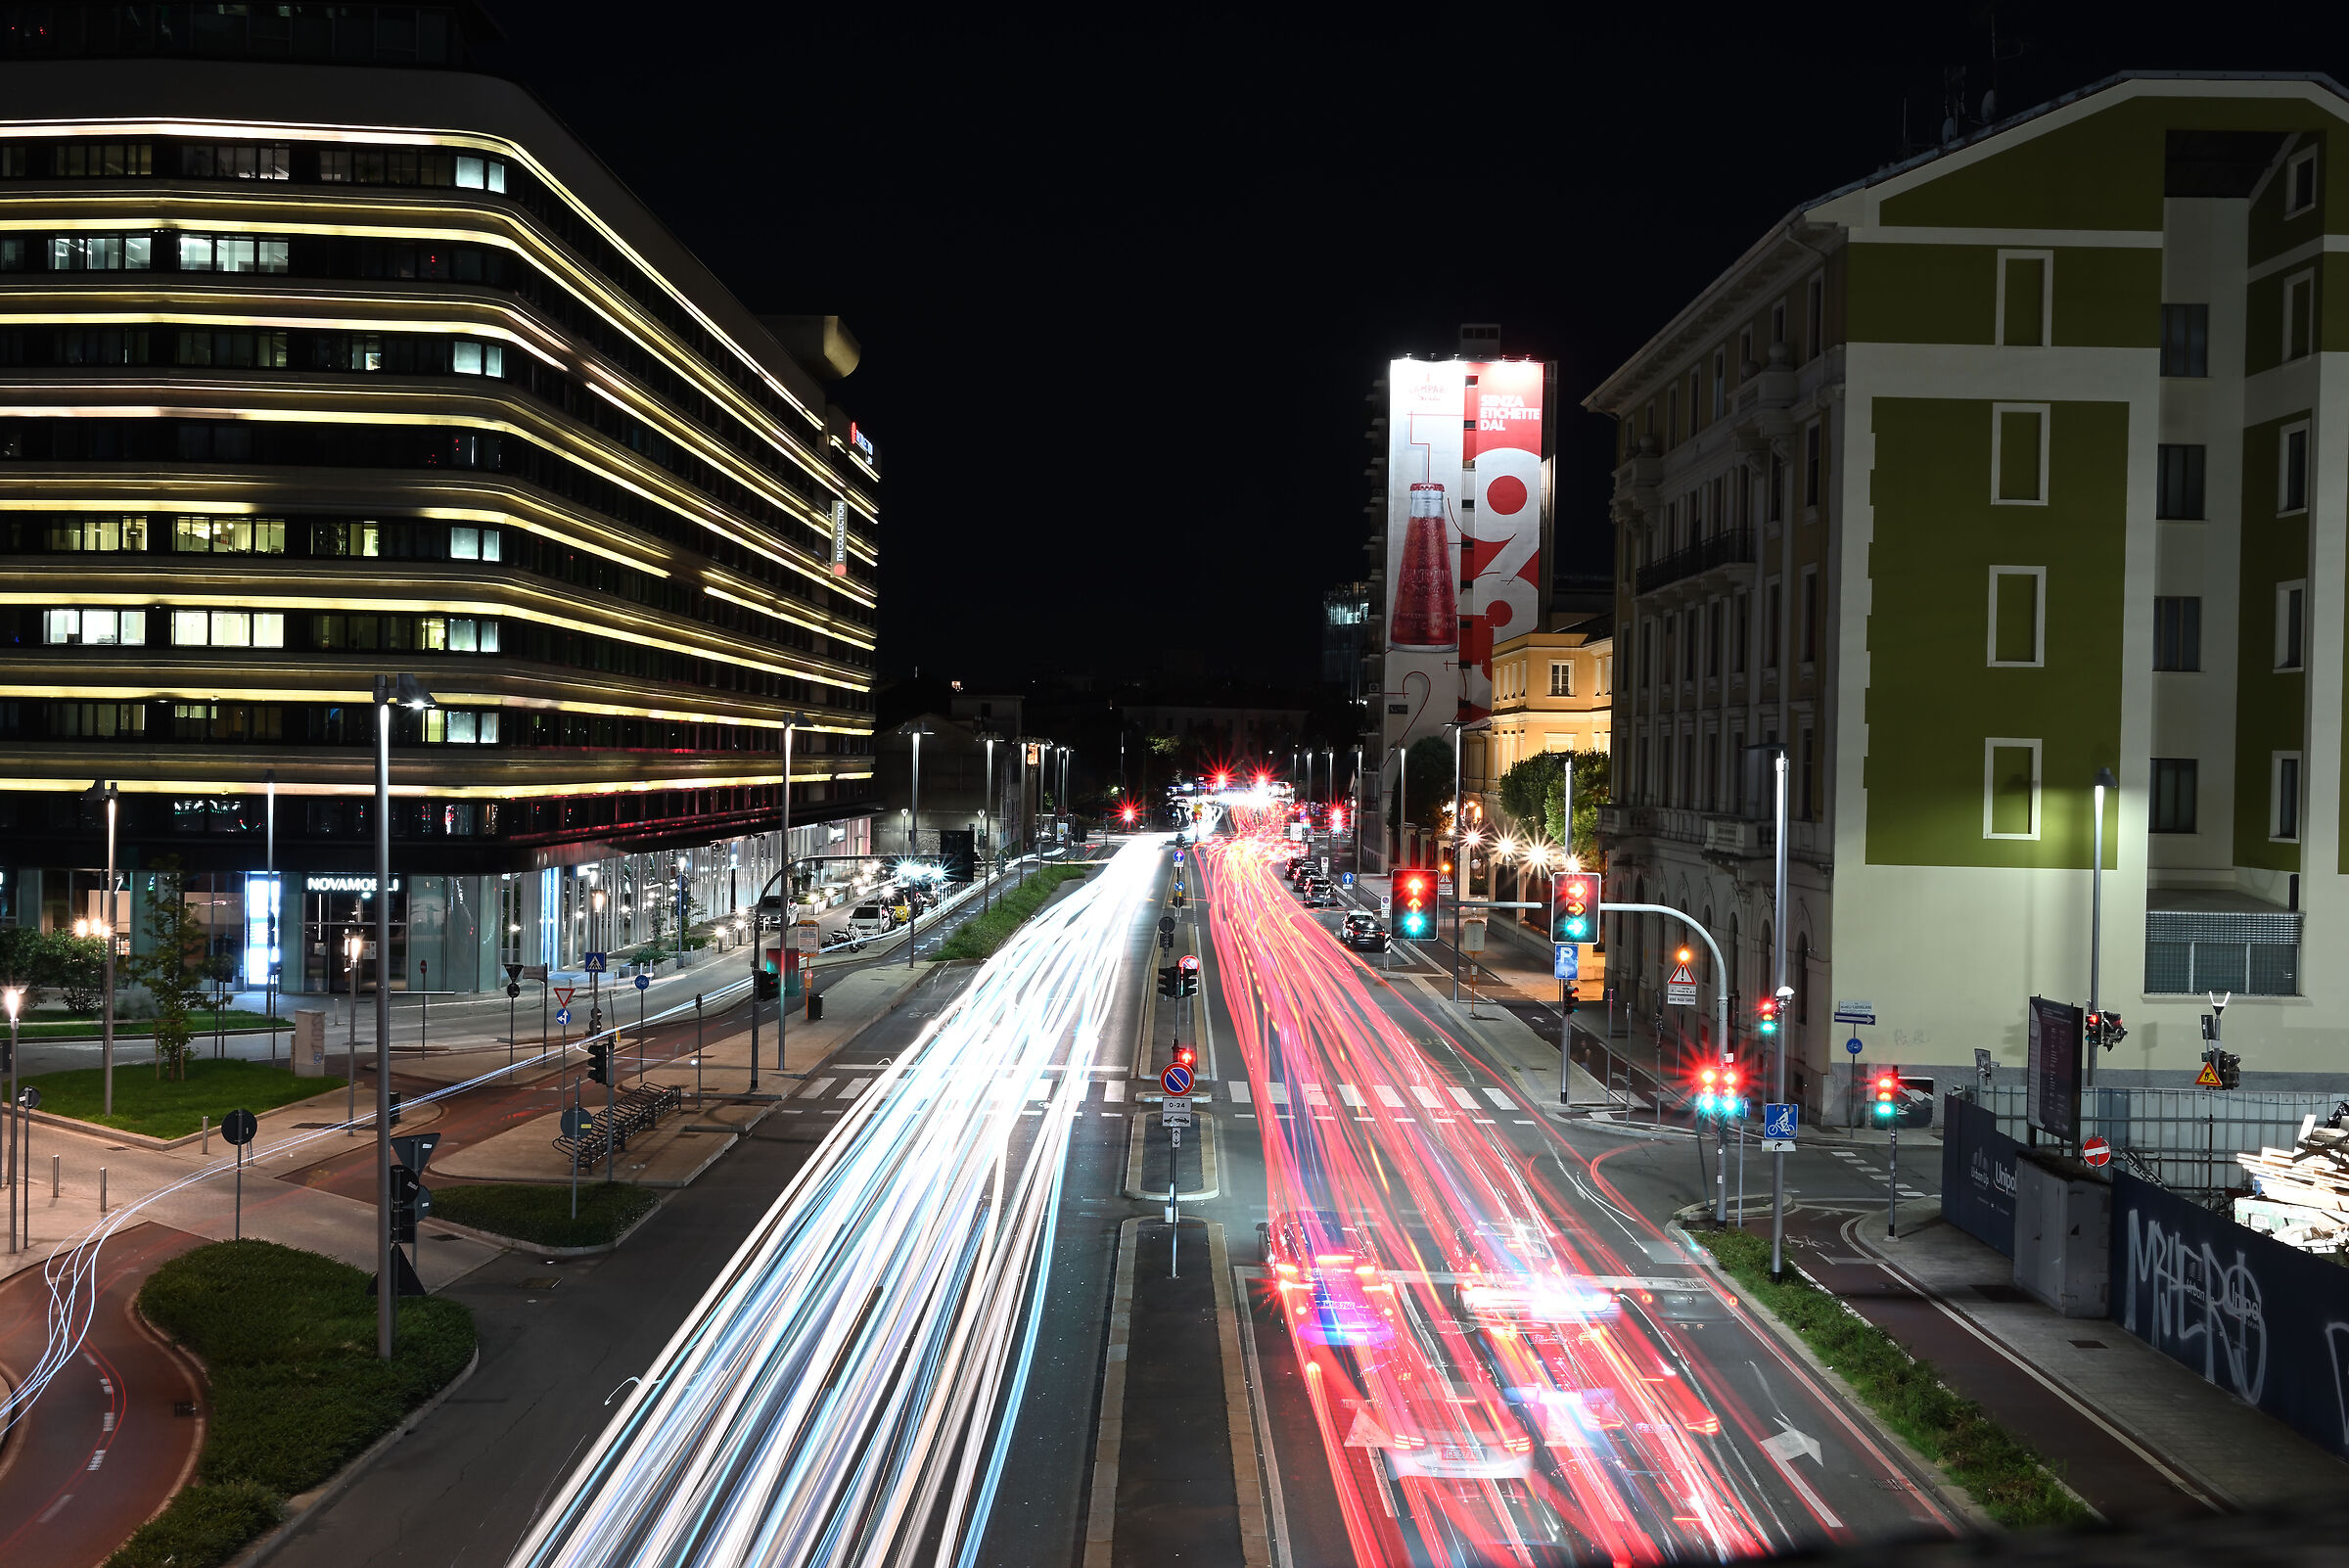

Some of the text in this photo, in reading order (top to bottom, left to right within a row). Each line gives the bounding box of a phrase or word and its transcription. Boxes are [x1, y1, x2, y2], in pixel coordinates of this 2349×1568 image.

[1480, 394, 1524, 407] SENZA
[1480, 408, 1541, 420] ETICHETTE
[1480, 419, 1505, 431] DAL
[836, 502, 845, 550] COLLECTION
[307, 877, 399, 892] NOVAMOBI
[1560, 946, 1573, 963] P
